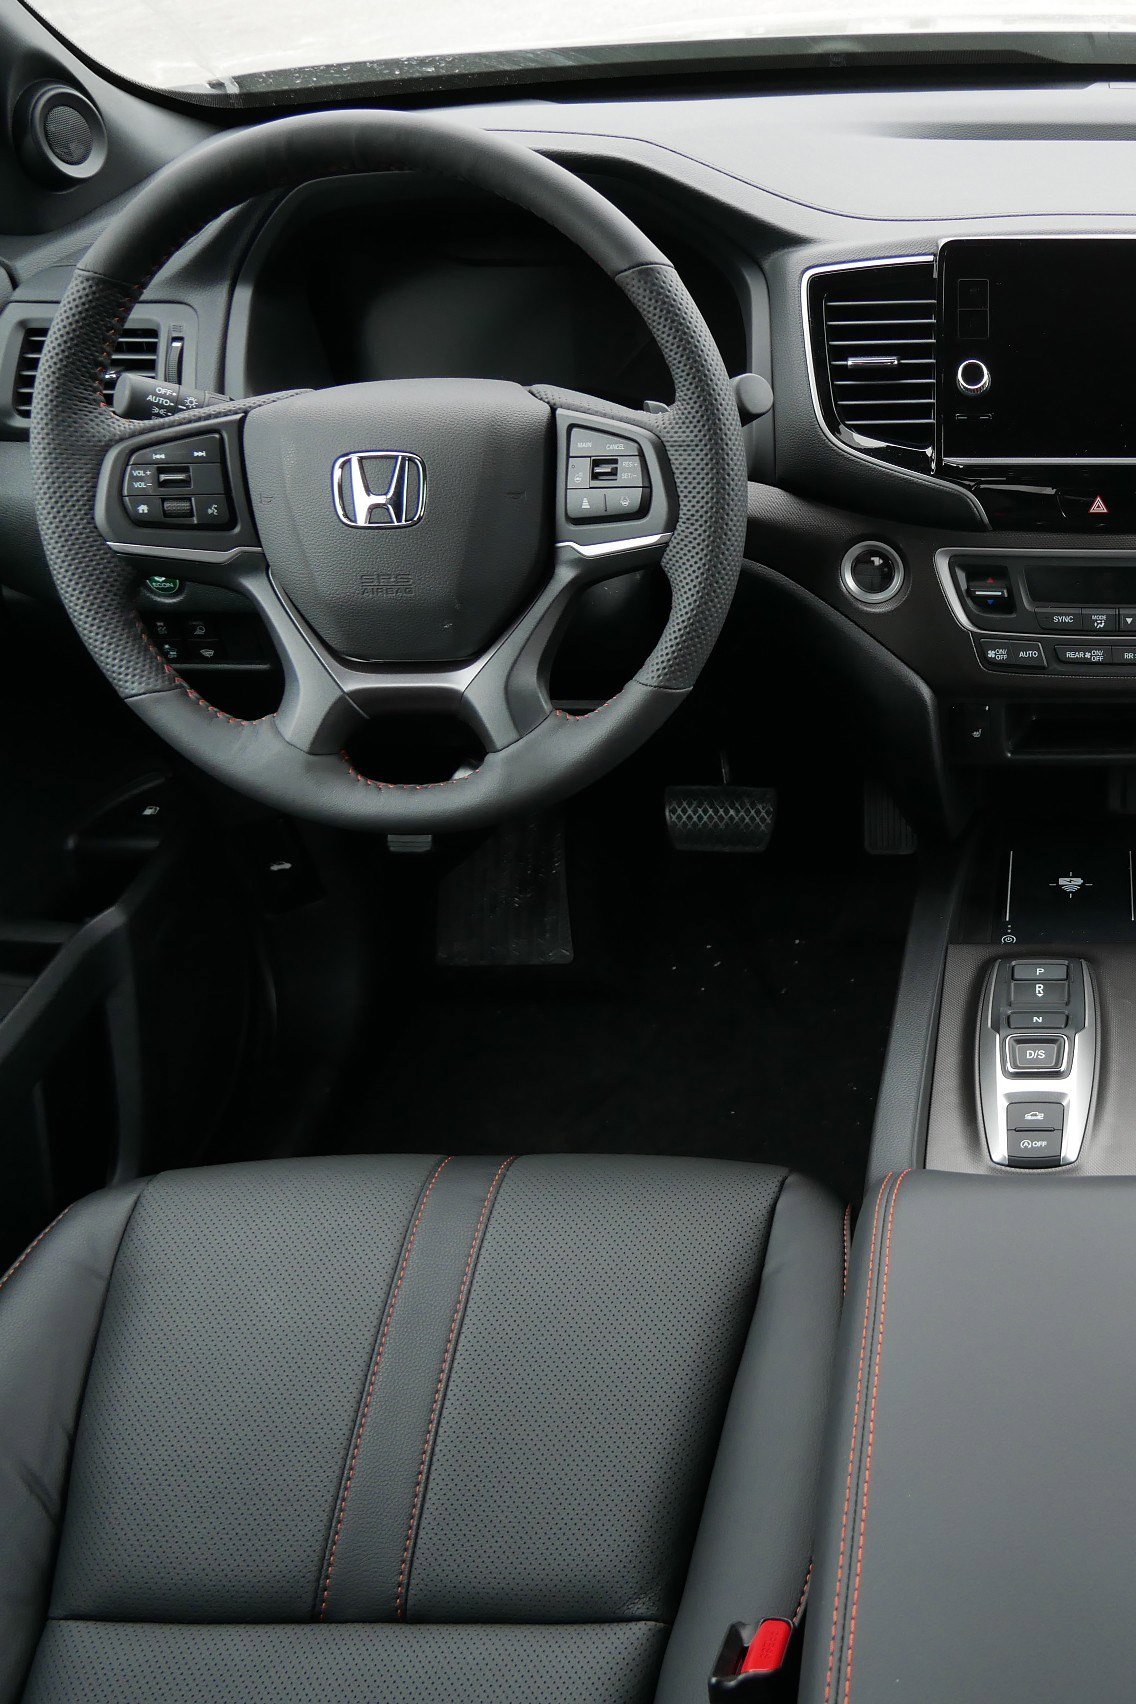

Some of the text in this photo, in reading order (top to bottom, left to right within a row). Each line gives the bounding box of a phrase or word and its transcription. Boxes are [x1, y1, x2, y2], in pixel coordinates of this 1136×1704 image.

[156, 386, 172, 396] OFF
[146, 395, 170, 406] AUTO
[1036, 984, 1044, 994] R
[1026, 1050, 1045, 1059] D/S
